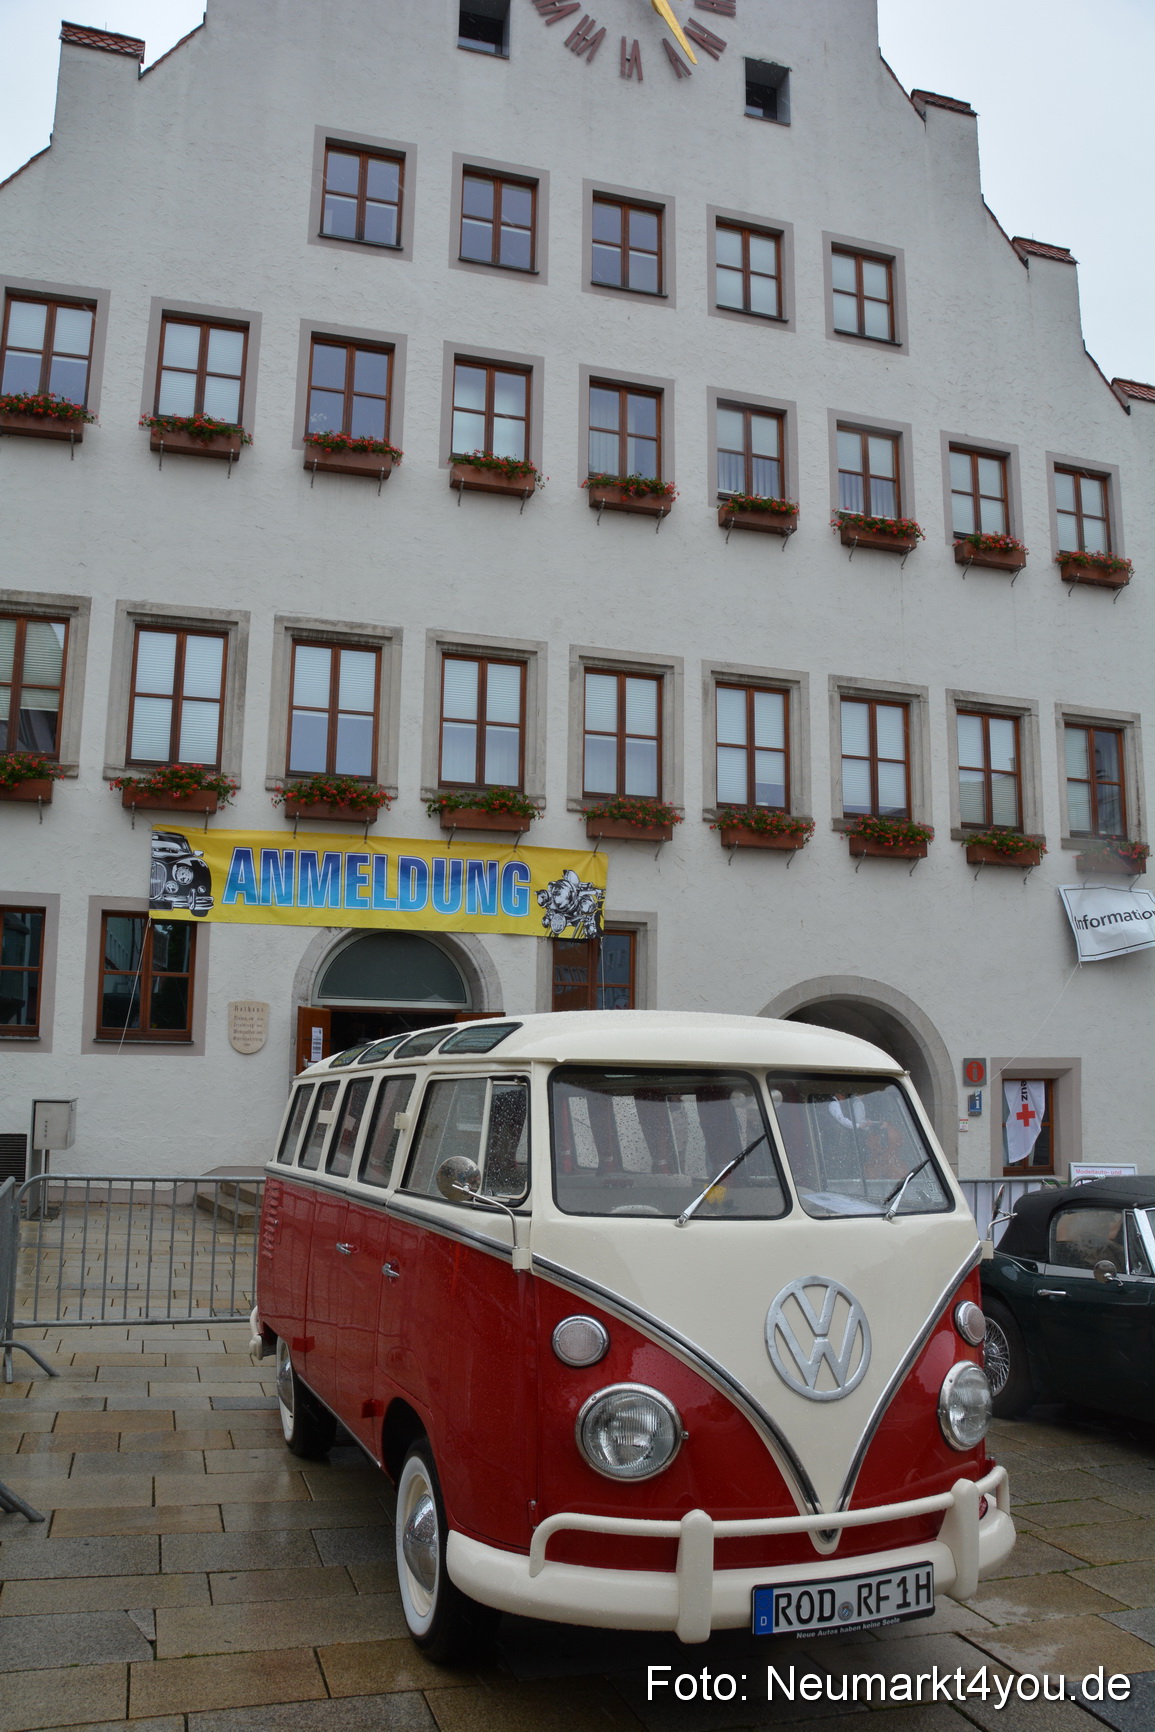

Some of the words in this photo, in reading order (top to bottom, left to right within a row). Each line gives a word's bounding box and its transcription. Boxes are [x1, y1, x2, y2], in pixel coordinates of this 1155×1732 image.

[222, 846, 532, 918] ANMELDUNG
[764, 1275, 872, 1401] VW
[760, 1616, 767, 1626] D
[774, 1588, 836, 1627] ROD
[796, 1631, 816, 1639] Neue
[817, 1628, 838, 1637] Autos
[839, 1624, 861, 1634] haben
[862, 1621, 881, 1631] keine
[882, 1616, 900, 1626] Seele
